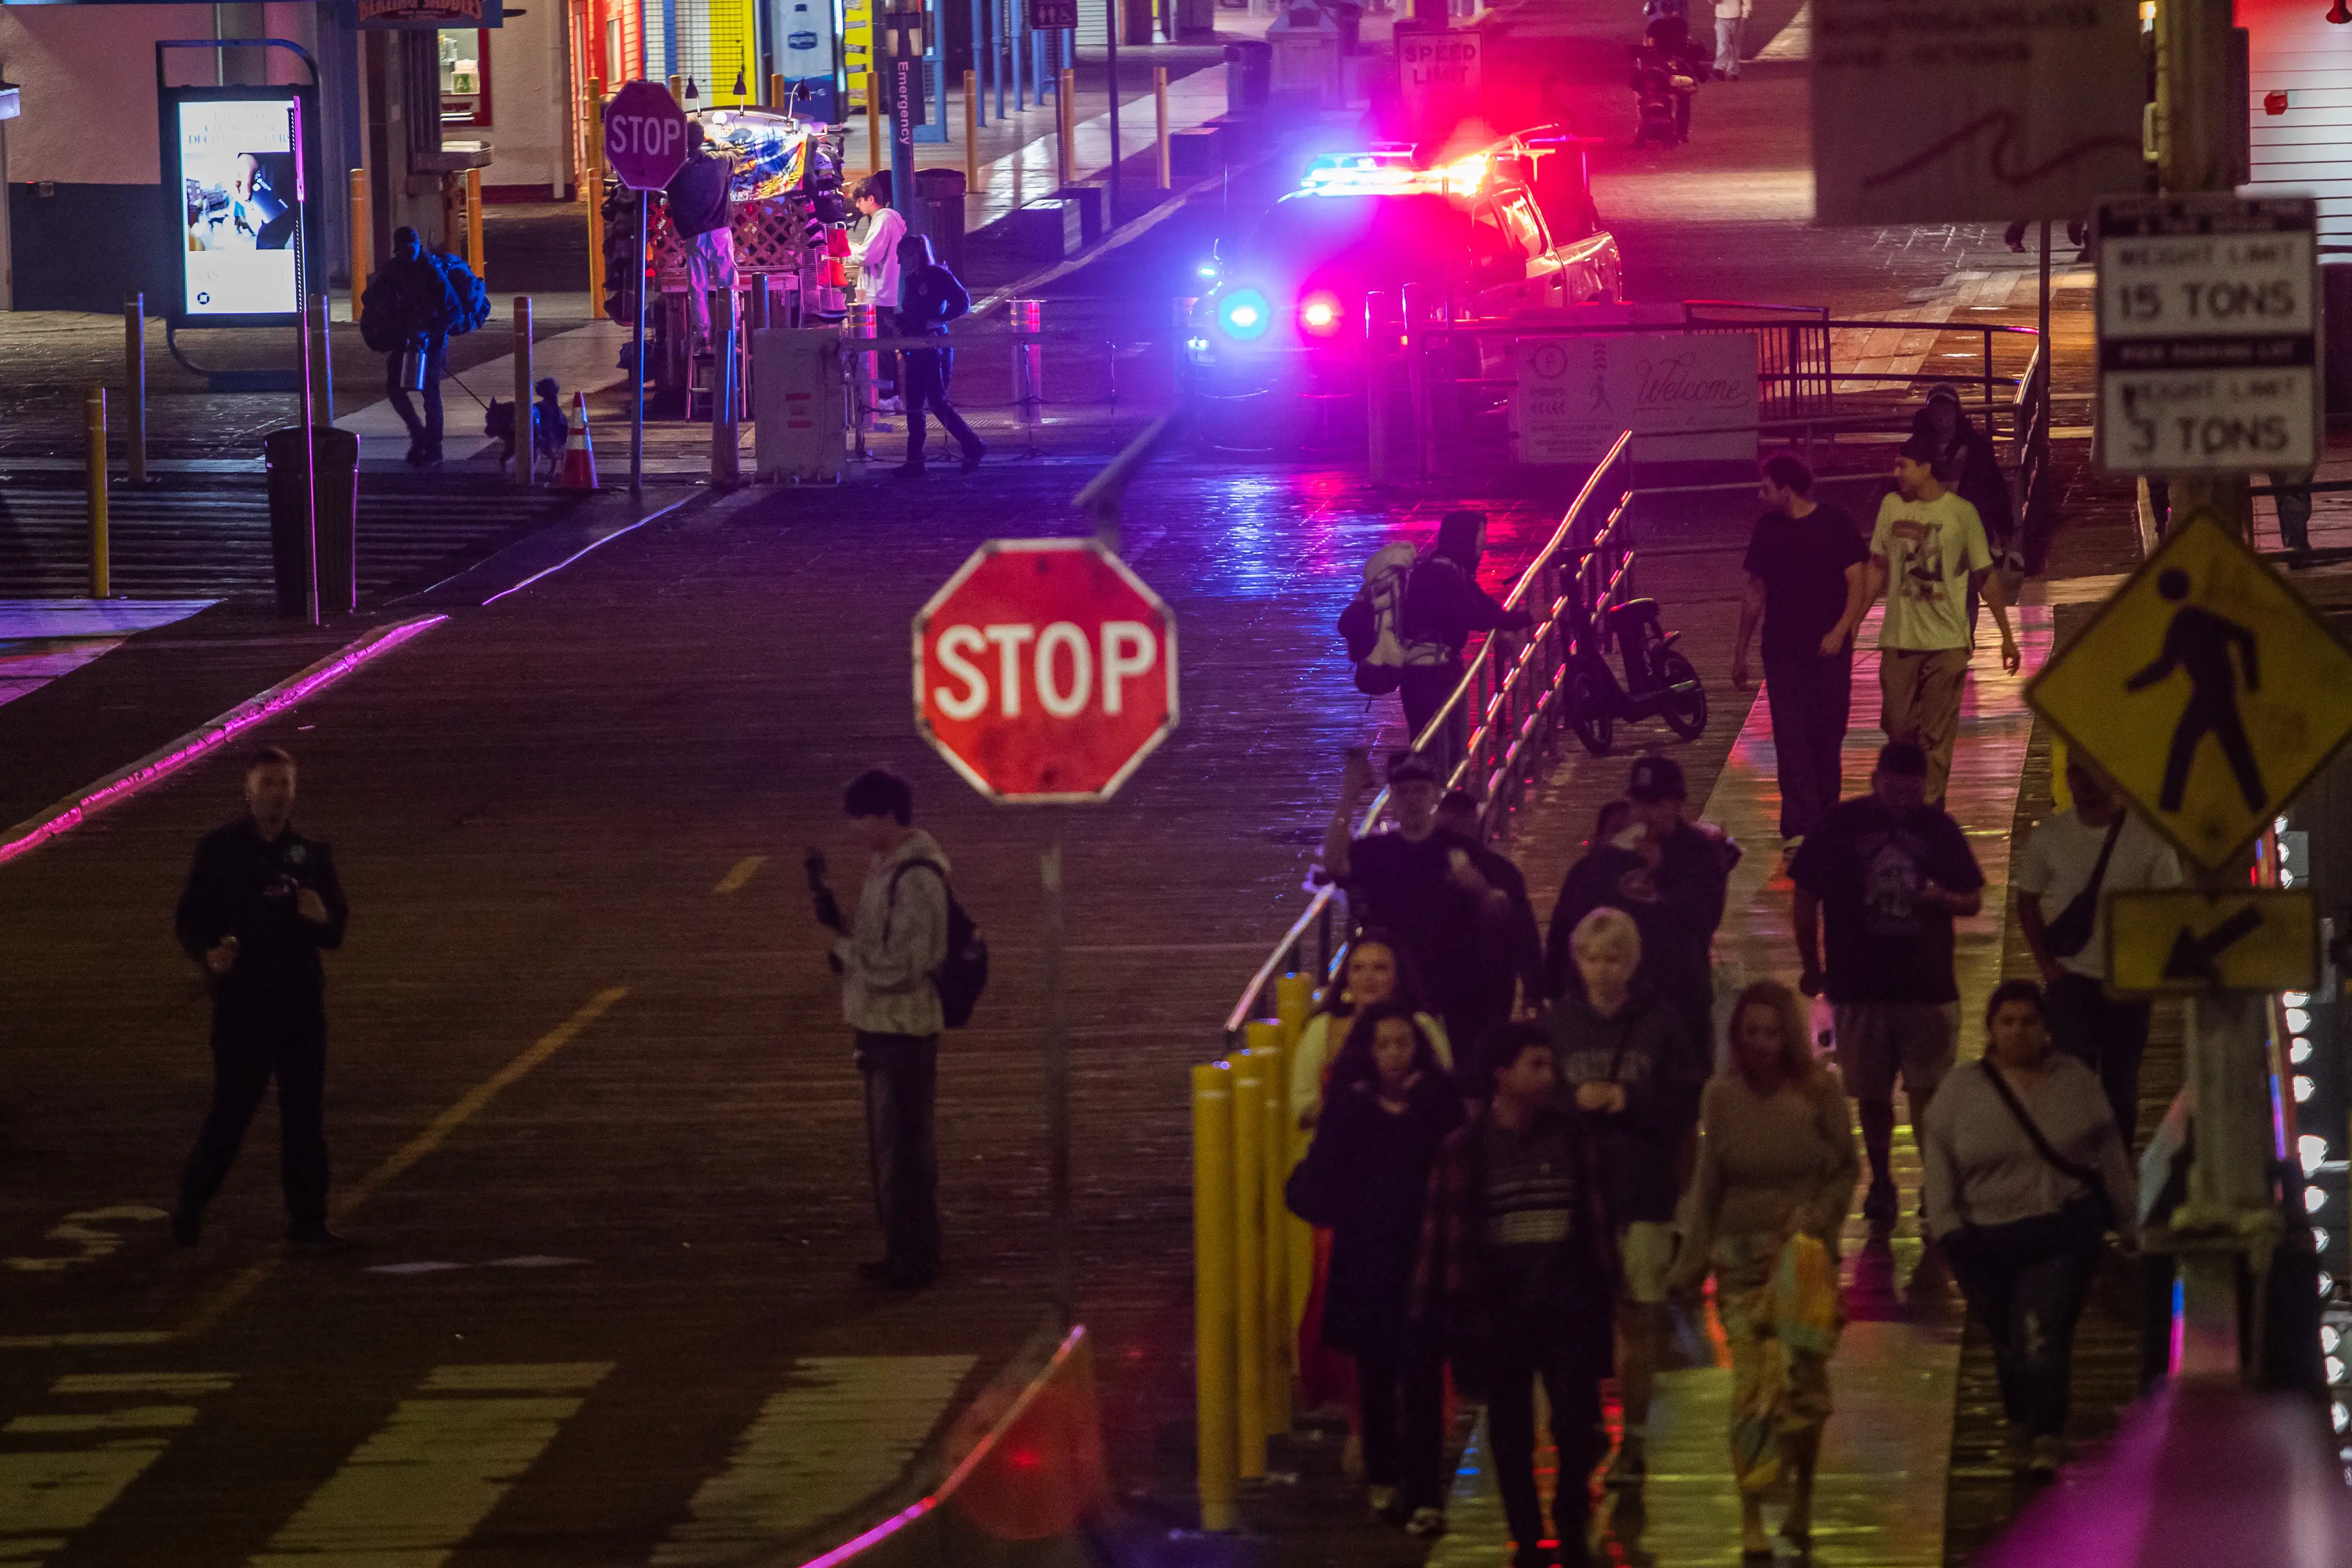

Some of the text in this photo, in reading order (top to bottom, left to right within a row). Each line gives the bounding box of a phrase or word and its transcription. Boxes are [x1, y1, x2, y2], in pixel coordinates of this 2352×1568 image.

[1405, 44, 1476, 62] SPEED
[1413, 66, 1469, 85] LIMIT
[897, 61, 910, 145] Emergency
[610, 115, 680, 156] STOP
[2120, 279, 2294, 322] 15 TONS
[1635, 352, 1750, 407] Welcome
[2177, 415, 2288, 455] TONS
[933, 620, 1158, 721] STOP
